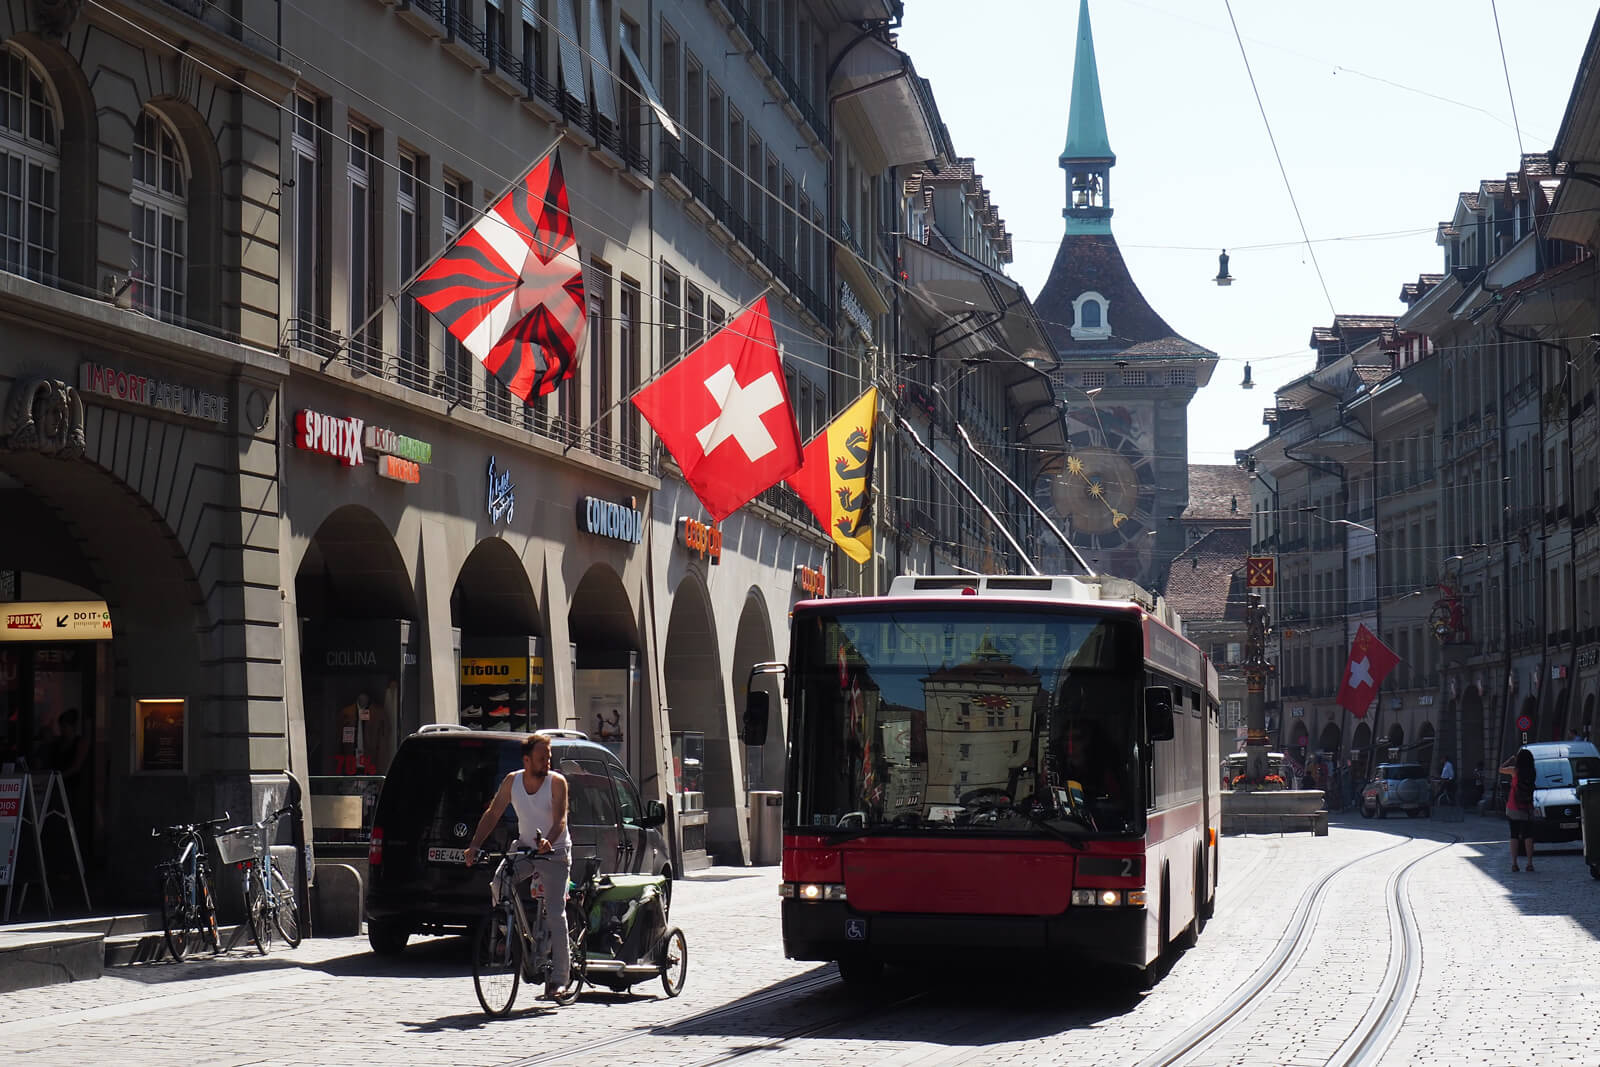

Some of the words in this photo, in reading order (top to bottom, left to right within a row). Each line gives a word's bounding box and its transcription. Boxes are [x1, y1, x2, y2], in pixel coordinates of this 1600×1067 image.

[86, 362, 148, 404] IMPORT
[147, 377, 230, 425] PARFUMERIE
[585, 495, 644, 545] CONCORDIA
[73, 612, 88, 620] DO
[326, 651, 377, 666] CIOLINA
[1120, 857, 1132, 877] 2
